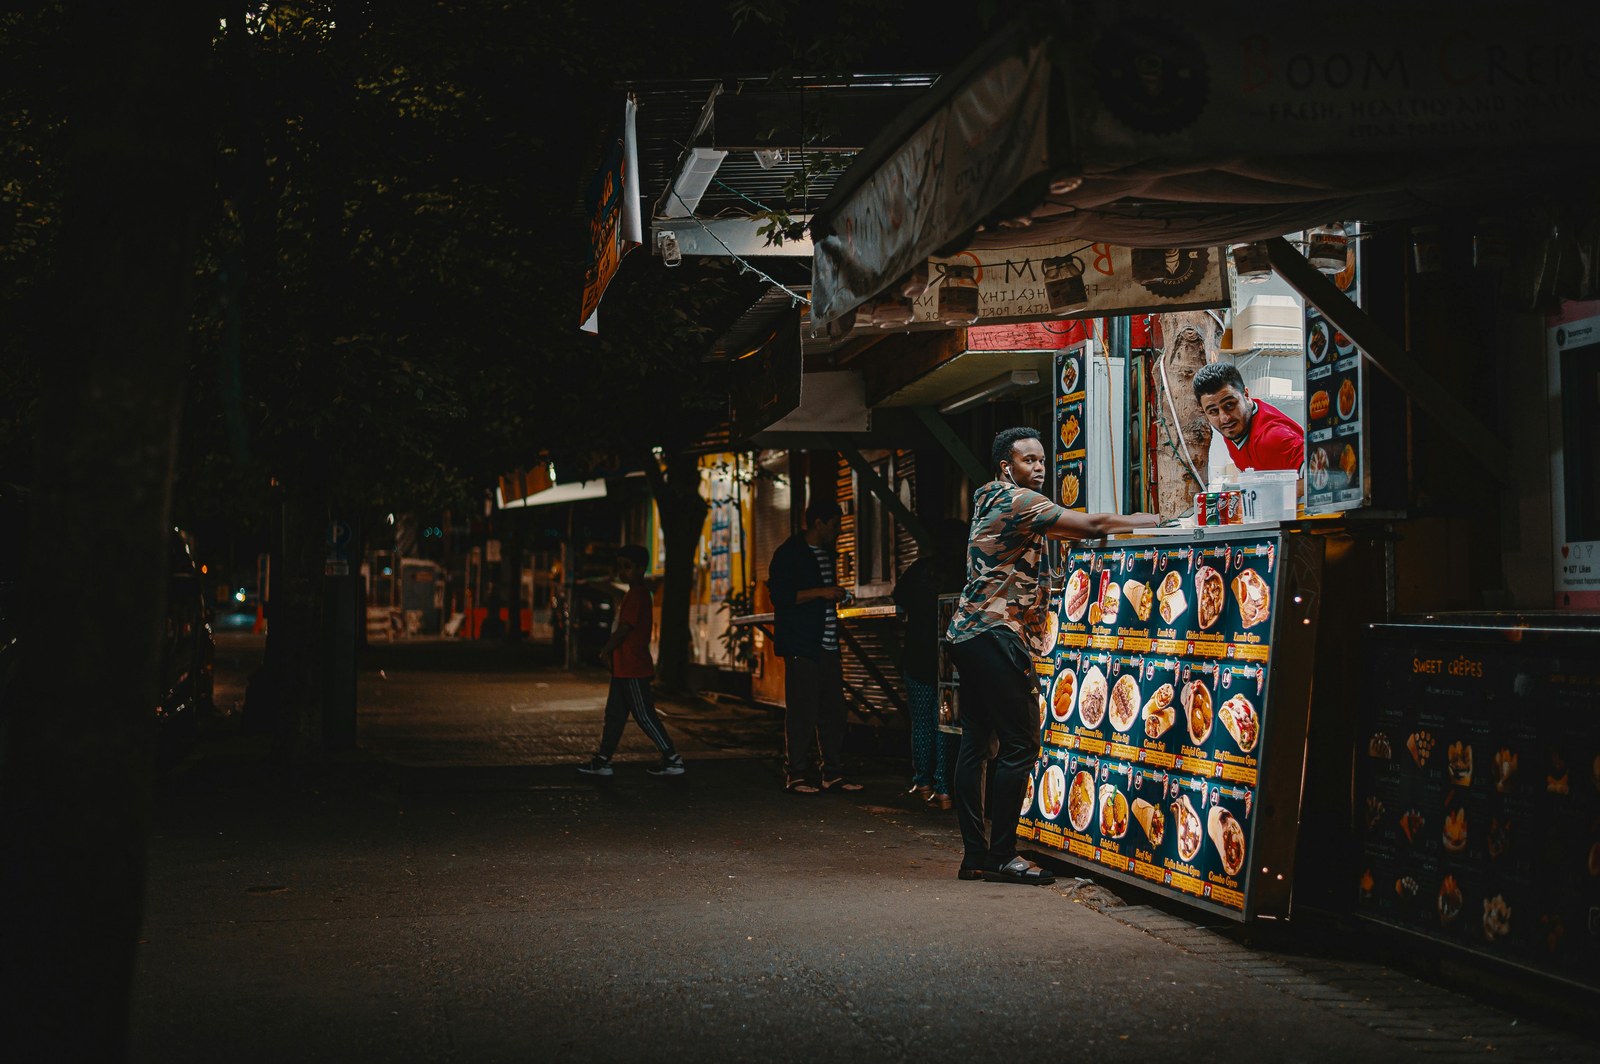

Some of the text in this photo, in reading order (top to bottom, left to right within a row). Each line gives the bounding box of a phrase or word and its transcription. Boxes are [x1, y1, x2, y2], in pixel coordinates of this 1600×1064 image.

[1238, 33, 1410, 93] BOOM
[1412, 657, 1444, 674] SWEET
[1208, 870, 1239, 890] Combo Gyro
